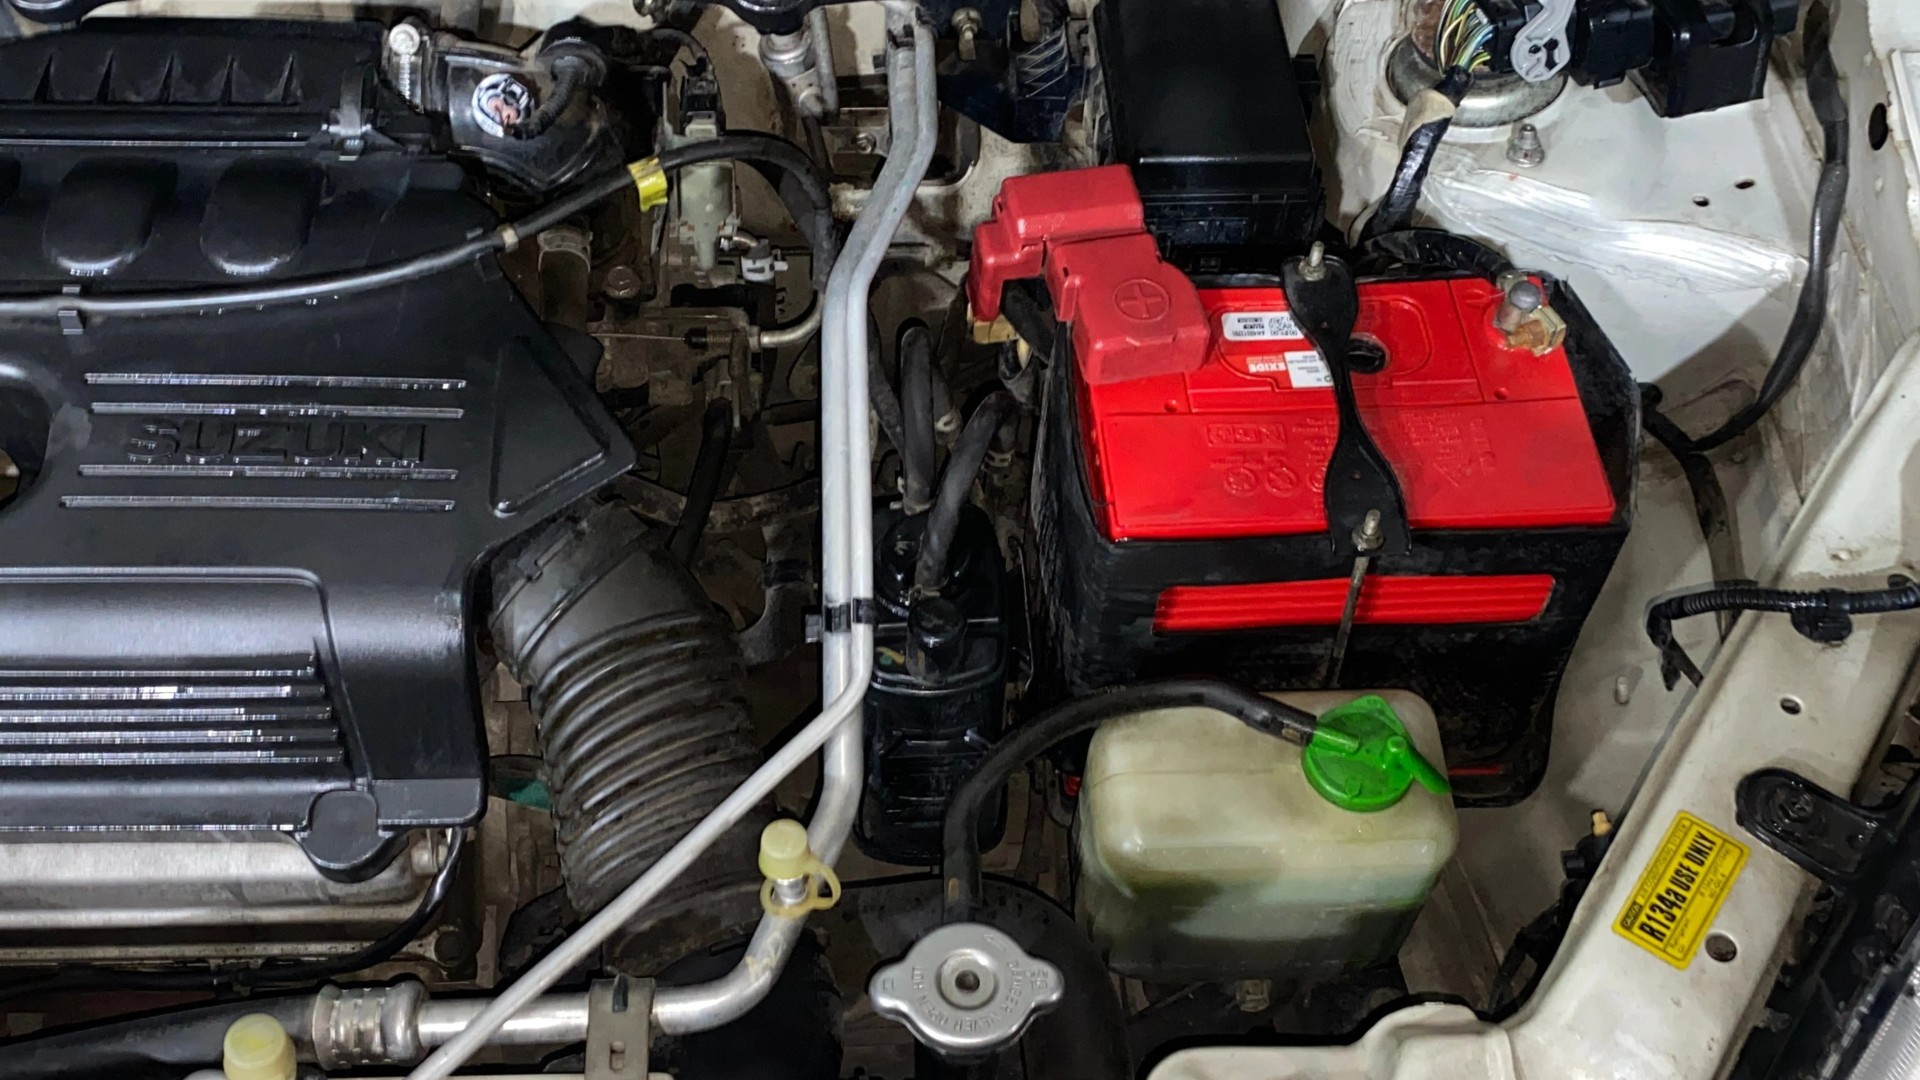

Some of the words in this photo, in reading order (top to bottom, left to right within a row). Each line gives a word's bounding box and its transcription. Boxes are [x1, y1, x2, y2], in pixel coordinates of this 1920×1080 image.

[1248, 361, 1287, 373] EXIDE
[126, 420, 426, 464] SUZUKI
[1638, 886, 1688, 943] R134a
[1668, 861, 1700, 892] USE
[1684, 830, 1717, 867] ONLY
